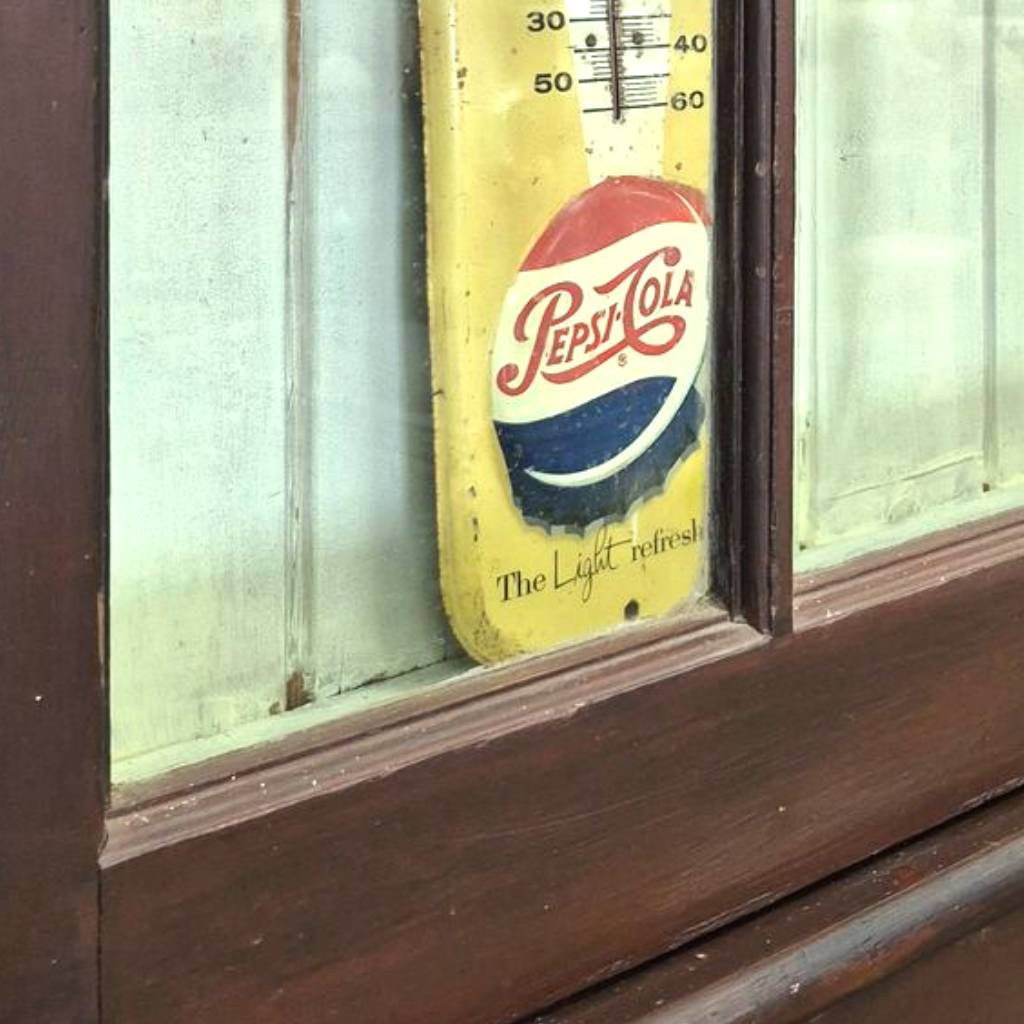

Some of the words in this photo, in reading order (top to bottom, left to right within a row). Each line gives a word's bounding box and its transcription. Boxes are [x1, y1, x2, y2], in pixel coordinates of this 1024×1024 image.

[527, 12, 565, 32] 30
[673, 33, 708, 52] 40
[534, 74, 573, 93] 50
[671, 91, 705, 110] 60
[497, 570, 546, 601] The
[553, 523, 632, 602] Light
